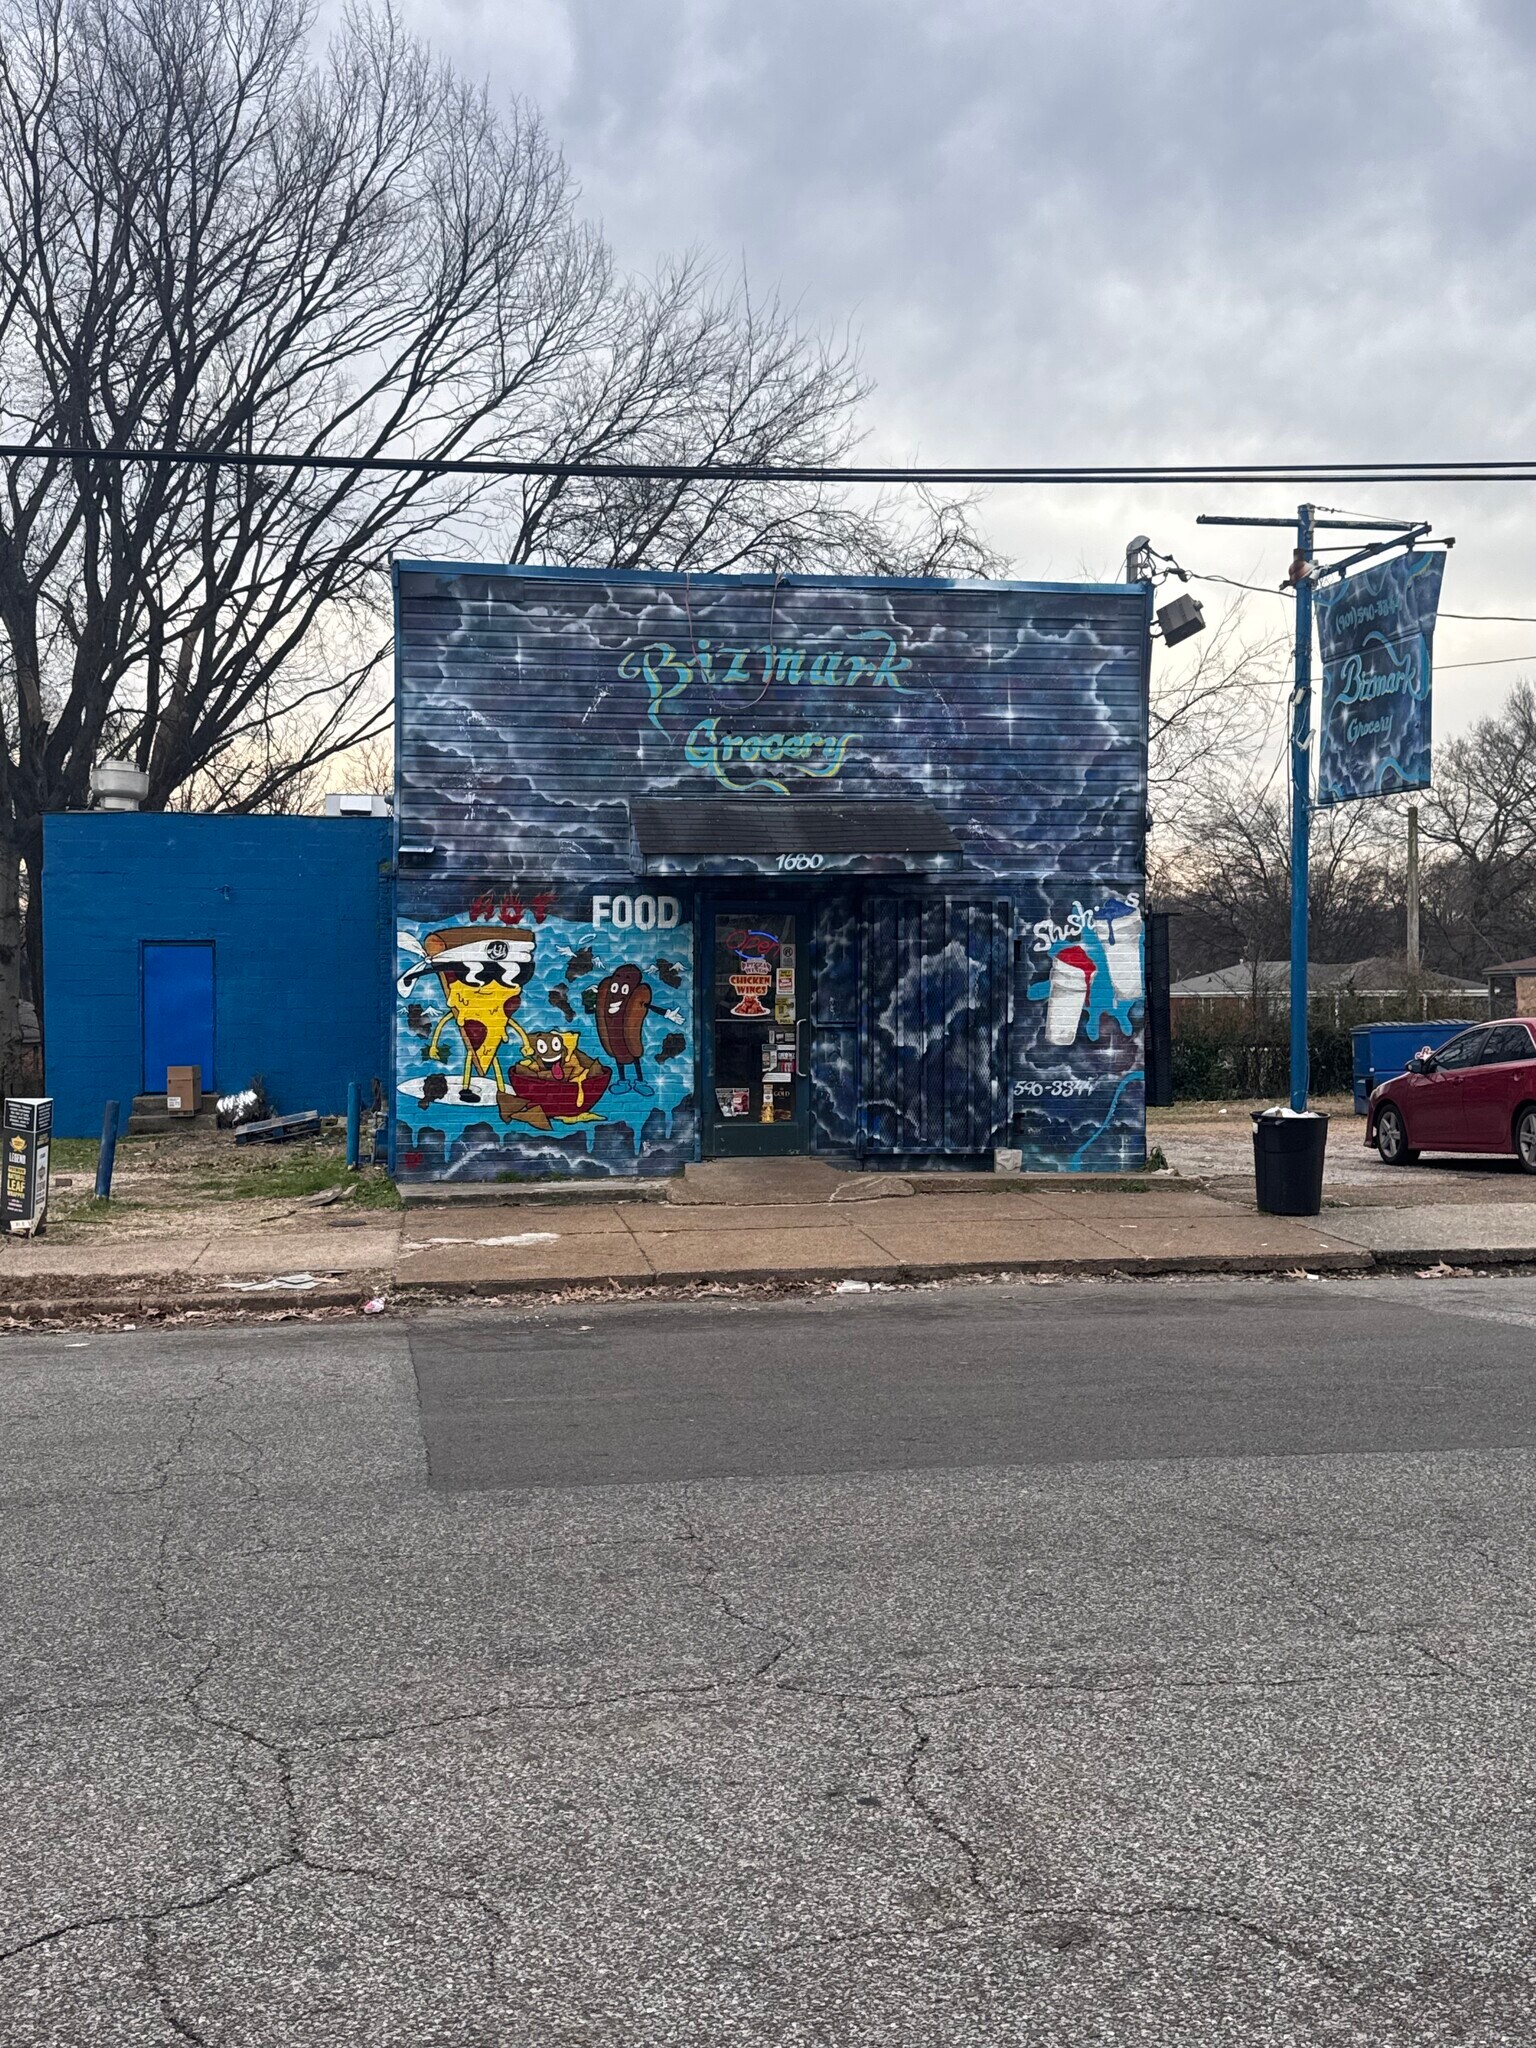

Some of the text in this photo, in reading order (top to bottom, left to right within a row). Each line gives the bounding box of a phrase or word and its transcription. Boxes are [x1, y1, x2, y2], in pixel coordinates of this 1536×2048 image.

[1338, 652, 1418, 705] Bizmark
[1347, 714, 1393, 745] Grocery
[685, 717, 863, 795] Grocery
[775, 853, 823, 870] 1680
[592, 895, 680, 930] FOOD
[1033, 892, 1140, 952] Slushs
[730, 976, 771, 985] CHICKEN
[737, 986, 767, 995] WINGS
[1013, 1080, 1097, 1097] 590-3344
[9, 1152, 26, 1165] LEGEND
[7, 1179, 26, 1193] LEAF
